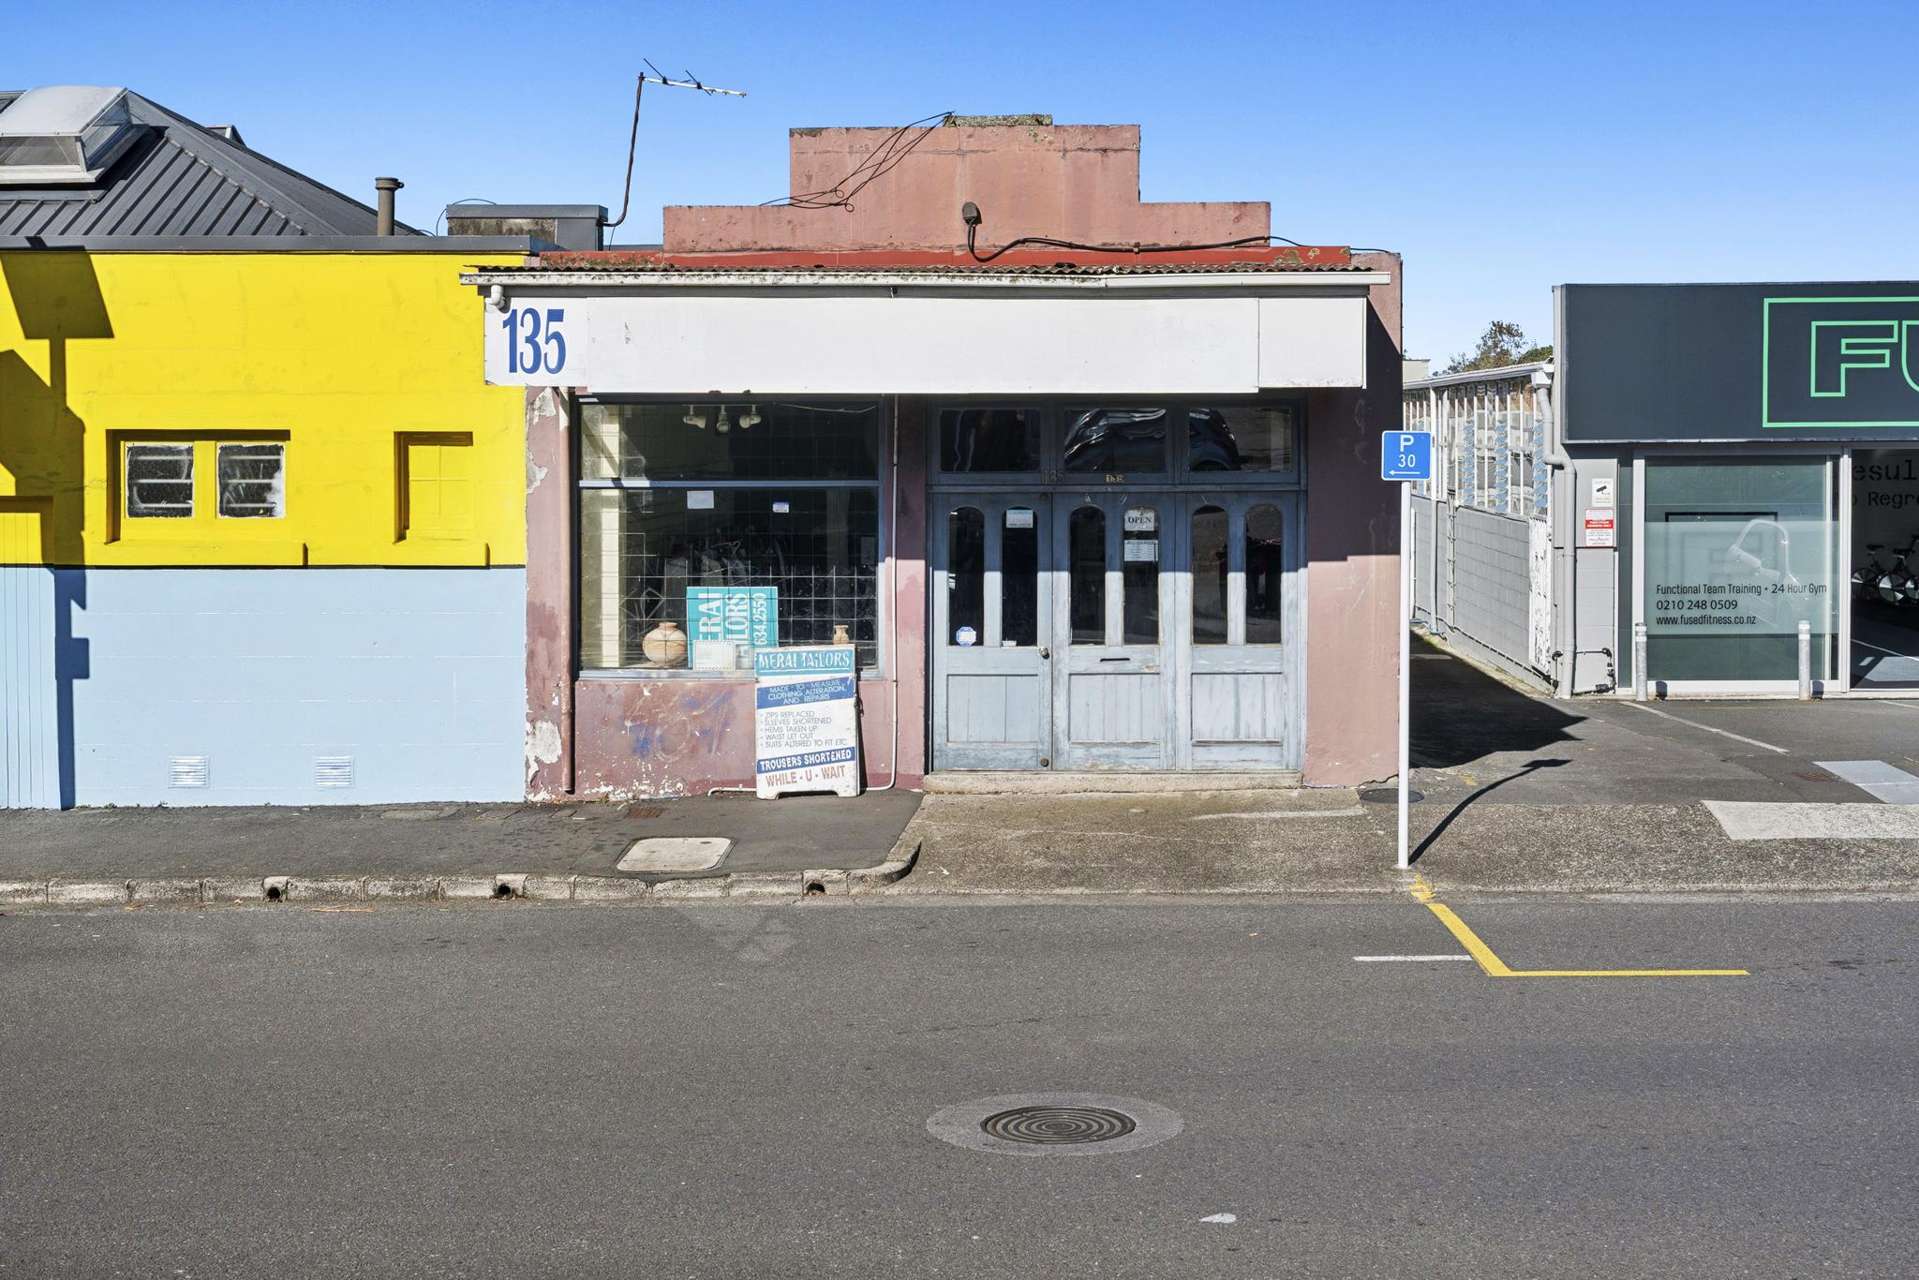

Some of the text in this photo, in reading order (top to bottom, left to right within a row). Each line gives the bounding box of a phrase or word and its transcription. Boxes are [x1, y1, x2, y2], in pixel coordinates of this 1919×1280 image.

[502, 307, 566, 375] 135
[1400, 434, 1414, 452] P
[1398, 454, 1416, 468] 30
[1867, 491, 1919, 509] Regr
[1127, 516, 1152, 524] OPEN
[1656, 583, 1827, 596] Functional Team Training 24 Hour Gym
[1656, 600, 1738, 610] 0210 248 0509
[1656, 614, 1757, 625] www.fusedfitness.co.nz
[759, 652, 797, 669] MERAI
[783, 697, 800, 705] AND
[791, 717, 832, 726] SHORTENED
[786, 725, 807, 733] TAKEN
[808, 725, 818, 733] UP
[799, 732, 814, 740] OUT
[765, 741, 782, 749] SUITS
[784, 740, 812, 748] ALTERED
[814, 739, 823, 747] TO
[760, 749, 851, 771] TROUSERS SHORTENED
[765, 765, 846, 787] WHILE U WAIT
